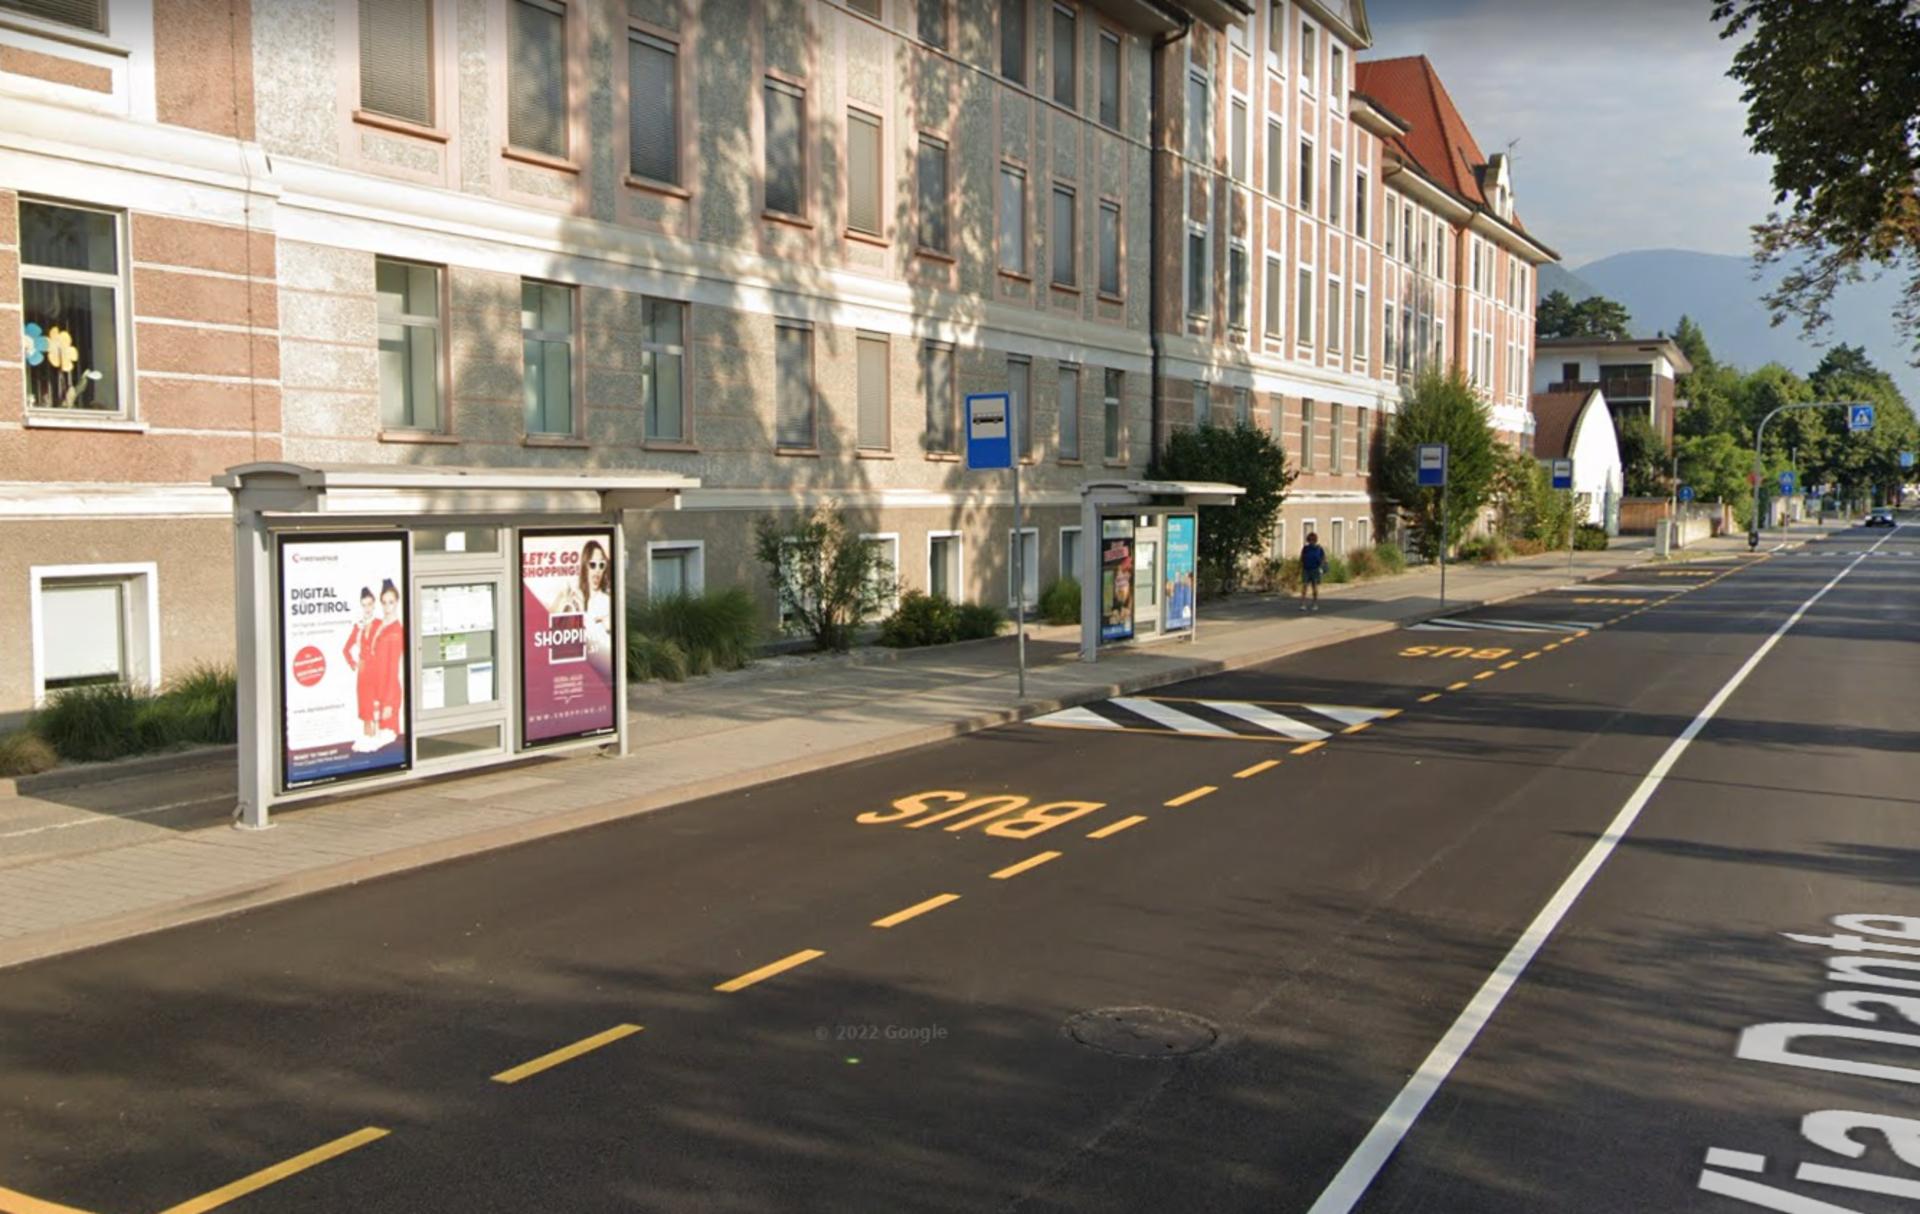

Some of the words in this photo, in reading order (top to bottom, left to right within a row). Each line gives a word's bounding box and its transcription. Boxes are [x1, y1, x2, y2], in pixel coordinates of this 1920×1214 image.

[523, 551, 556, 565] LET'S
[560, 550, 579, 564] GO
[523, 565, 580, 578] SHOPPING!
[291, 587, 337, 601] DIGITAL
[291, 600, 351, 616] SÜDTIROL
[1397, 645, 1514, 660] BUS
[856, 790, 1107, 840] BUS
